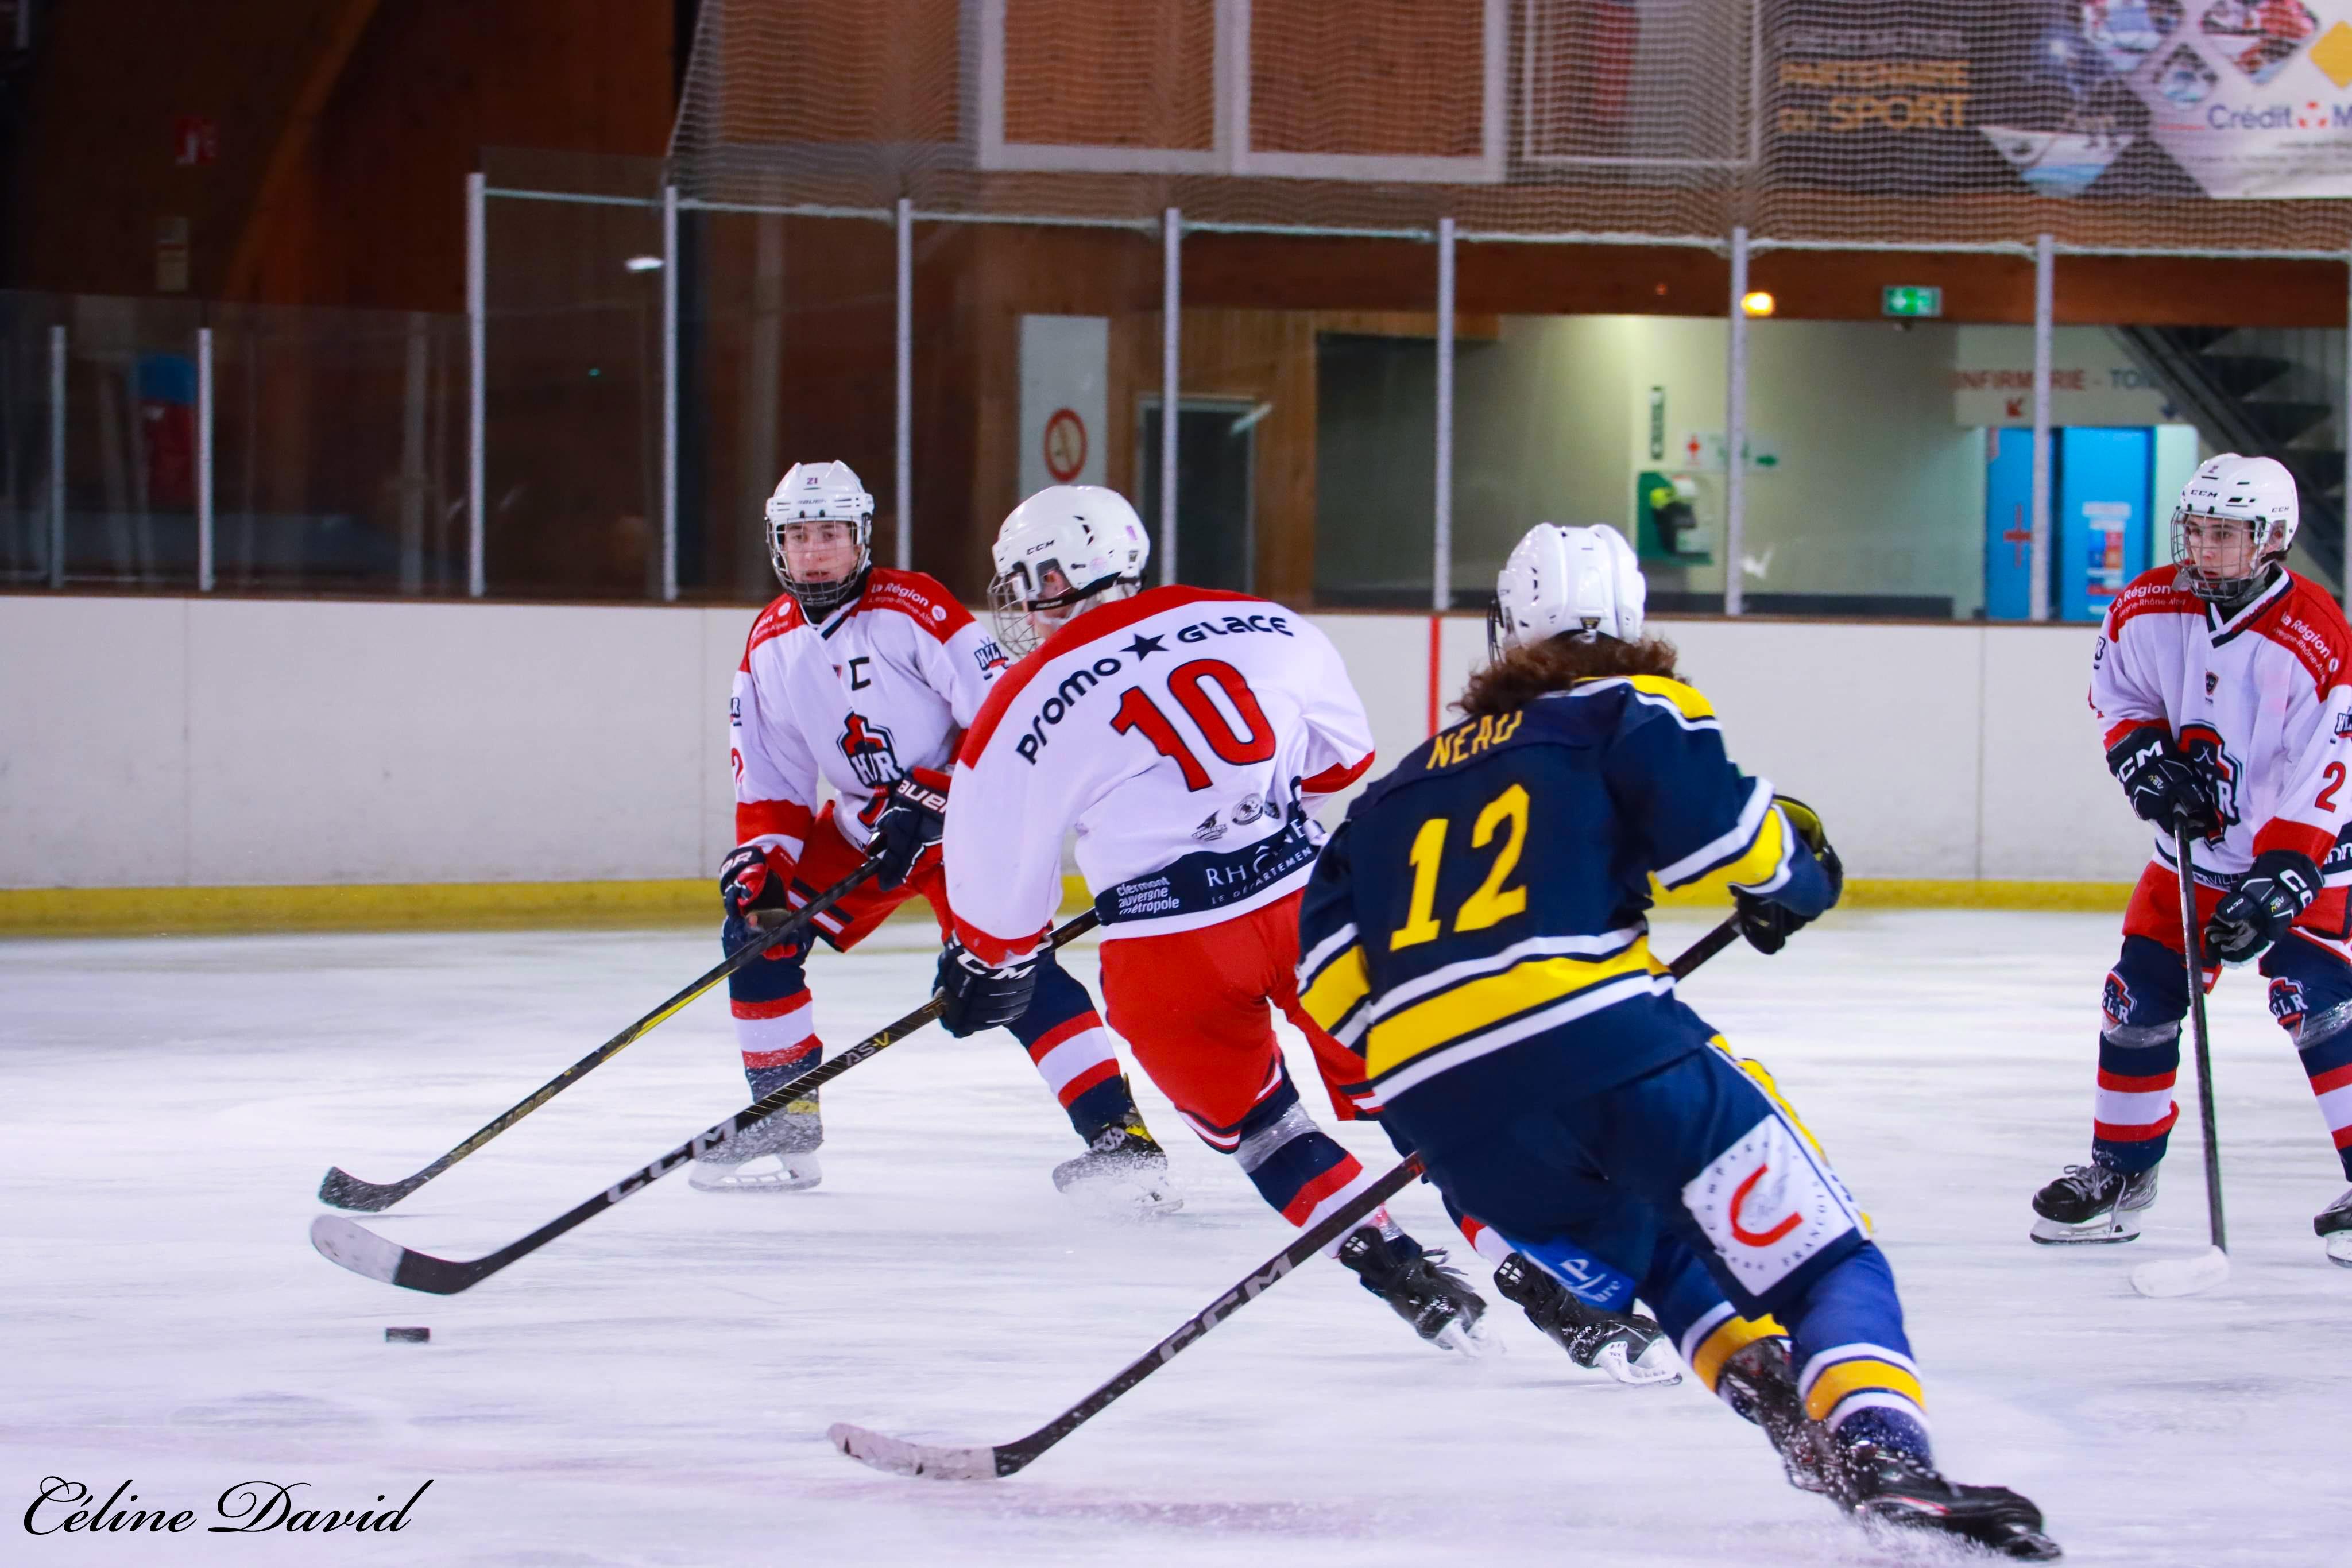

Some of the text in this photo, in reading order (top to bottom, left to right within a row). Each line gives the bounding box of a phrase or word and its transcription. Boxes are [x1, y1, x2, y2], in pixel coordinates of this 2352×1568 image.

[1829, 93, 1971, 130] SPORT
[2208, 104, 2292, 129] Crédit
[1951, 369, 2084, 390] INFIRMRIE
[2191, 490, 2218, 498] CCM
[1026, 539, 1055, 556] CCM
[884, 583, 929, 607] Région
[2124, 583, 2171, 602] Région
[2291, 619, 2331, 659] Région
[849, 656, 870, 690] C
[1109, 658, 1276, 792] 10
[1426, 710, 1523, 770] NEAU
[2117, 740, 2164, 782] CM
[2314, 761, 2346, 813] 2
[1390, 783, 1530, 953] 12
[1116, 876, 1171, 896] clermont
[1118, 887, 1169, 908] auvergne
[1119, 896, 1180, 915] métropole
[606, 1116, 737, 1202] CCM
[1159, 1252, 1293, 1363] CCM
